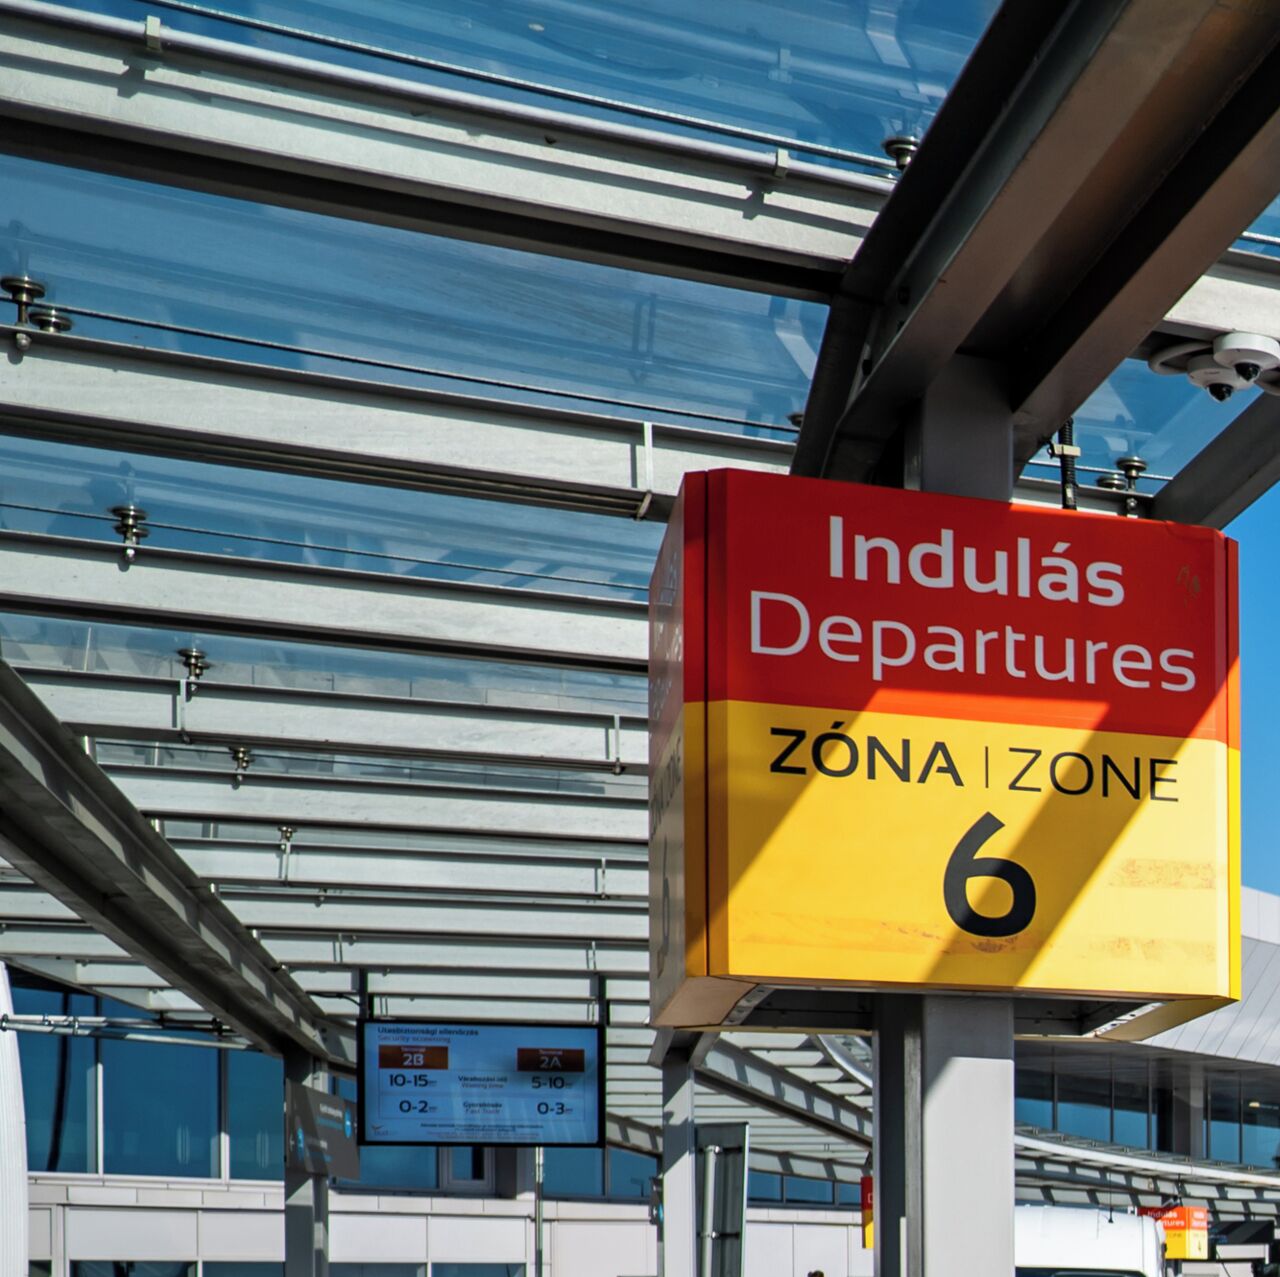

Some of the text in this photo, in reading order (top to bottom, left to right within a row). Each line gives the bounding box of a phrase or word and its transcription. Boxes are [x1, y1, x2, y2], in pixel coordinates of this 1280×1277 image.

[829, 515, 1125, 607] Indulás
[749, 590, 1197, 693] Departures
[769, 721, 1180, 802] ZÓNA ZONE
[942, 811, 1037, 937] 6
[402, 1053, 424, 1067] 2B
[539, 1056, 562, 1070] 2A
[389, 1074, 429, 1088] 10-15
[531, 1076, 565, 1090] 5-10
[399, 1100, 429, 1114] 0-2
[537, 1102, 566, 1116] 0-3
